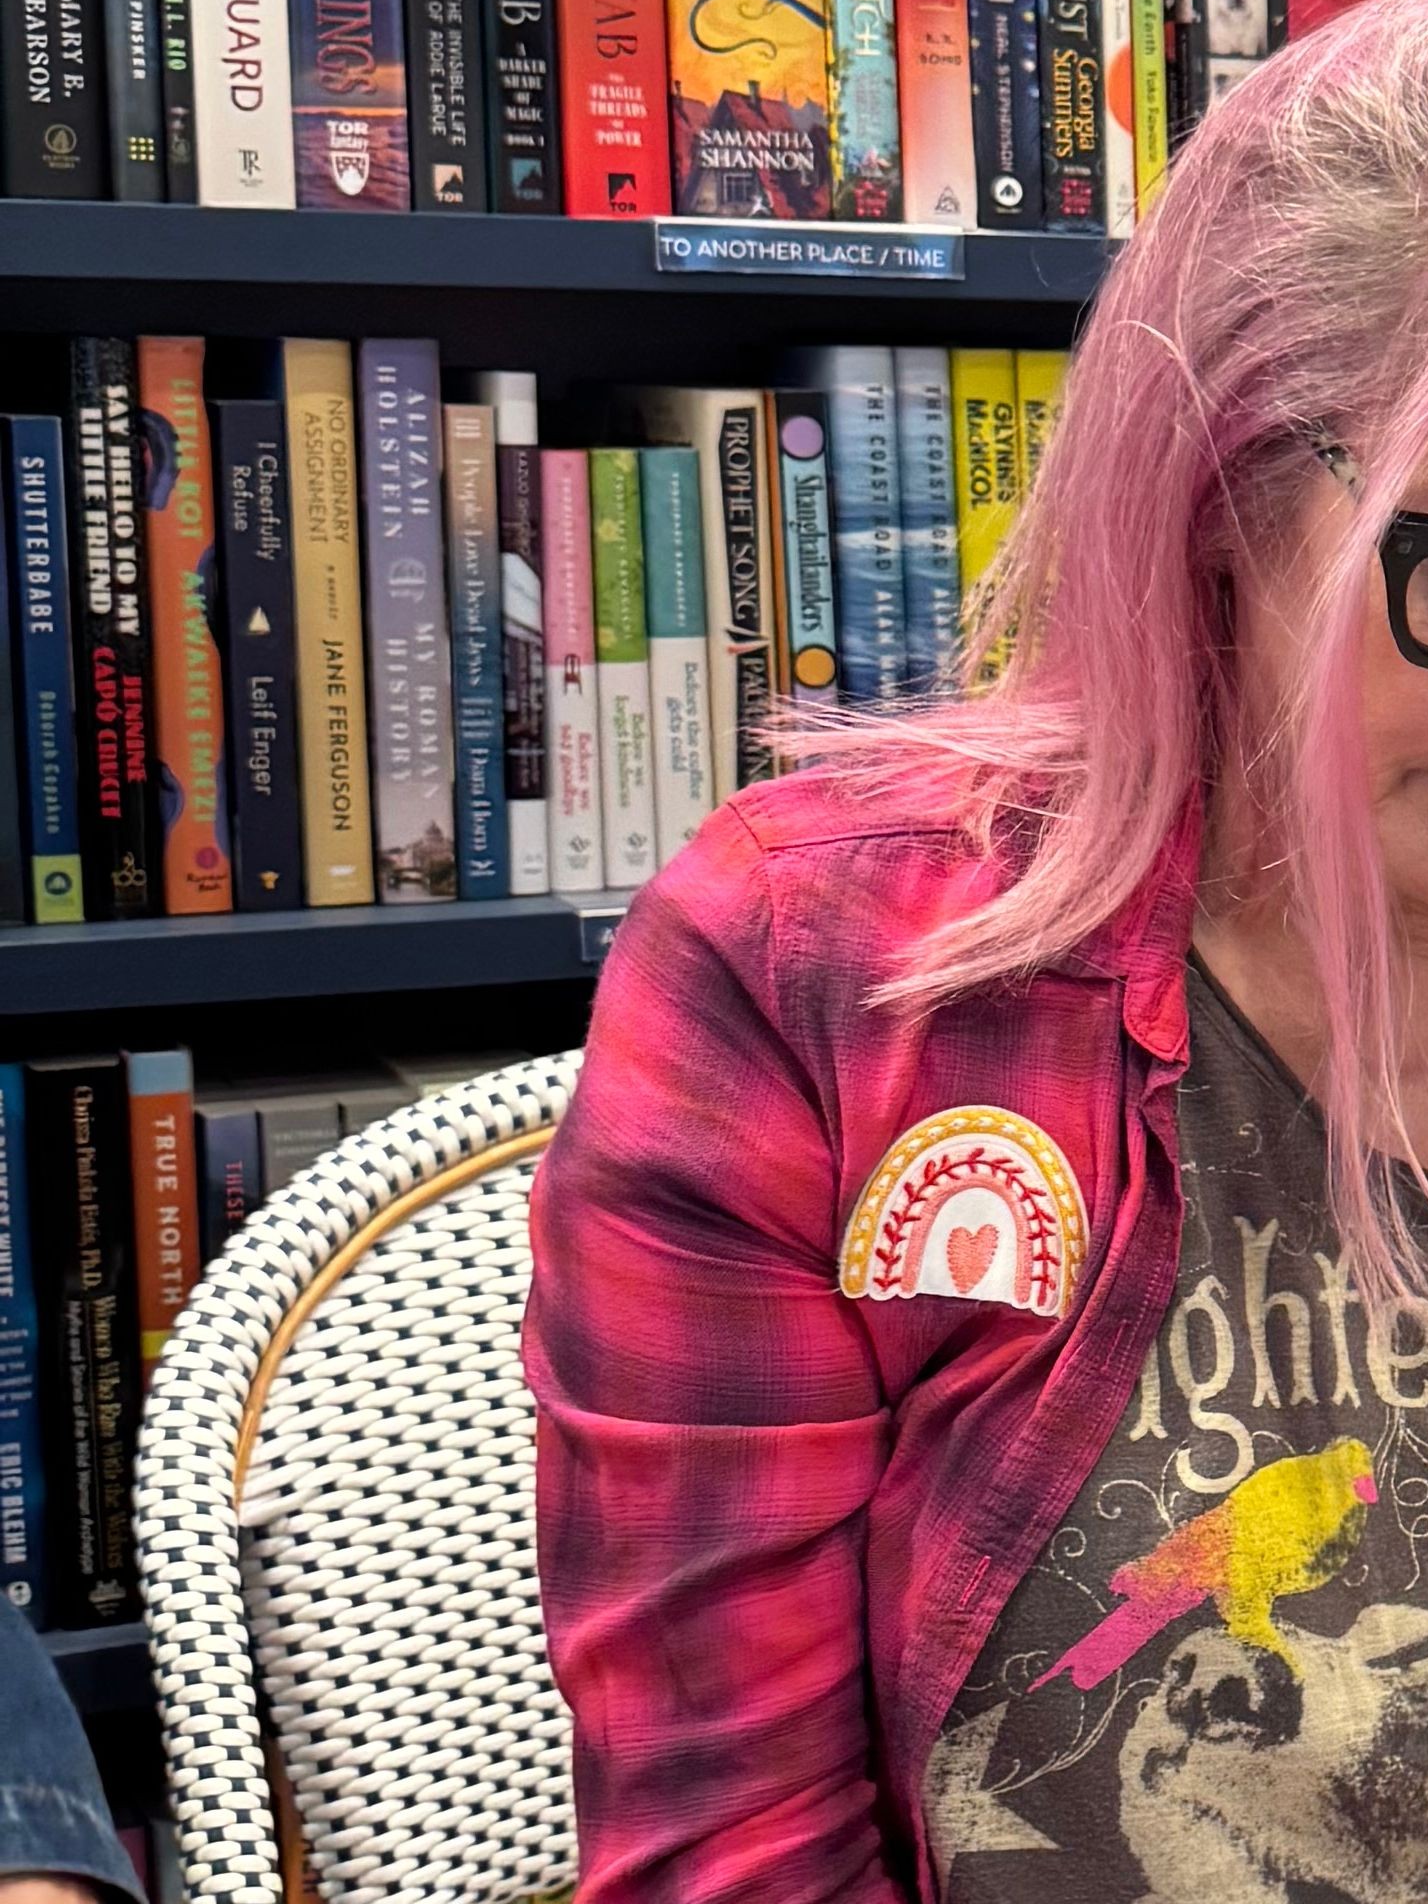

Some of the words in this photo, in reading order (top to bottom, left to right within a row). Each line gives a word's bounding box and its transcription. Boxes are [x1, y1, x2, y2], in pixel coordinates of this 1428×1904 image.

[660, 236, 692, 257] TO
[697, 240, 803, 262] ANOTHER
[808, 244, 874, 265] PLACE
[894, 248, 945, 268] TIME
[725, 416, 754, 528] PROPHET
[21, 456, 54, 635] SHUTTERBABE
[729, 544, 760, 627] SONG
[322, 638, 349, 702] JANE
[326, 710, 354, 832] FERGUSON
[152, 1116, 179, 1193] TRUE
[155, 1201, 182, 1305] NORTH
